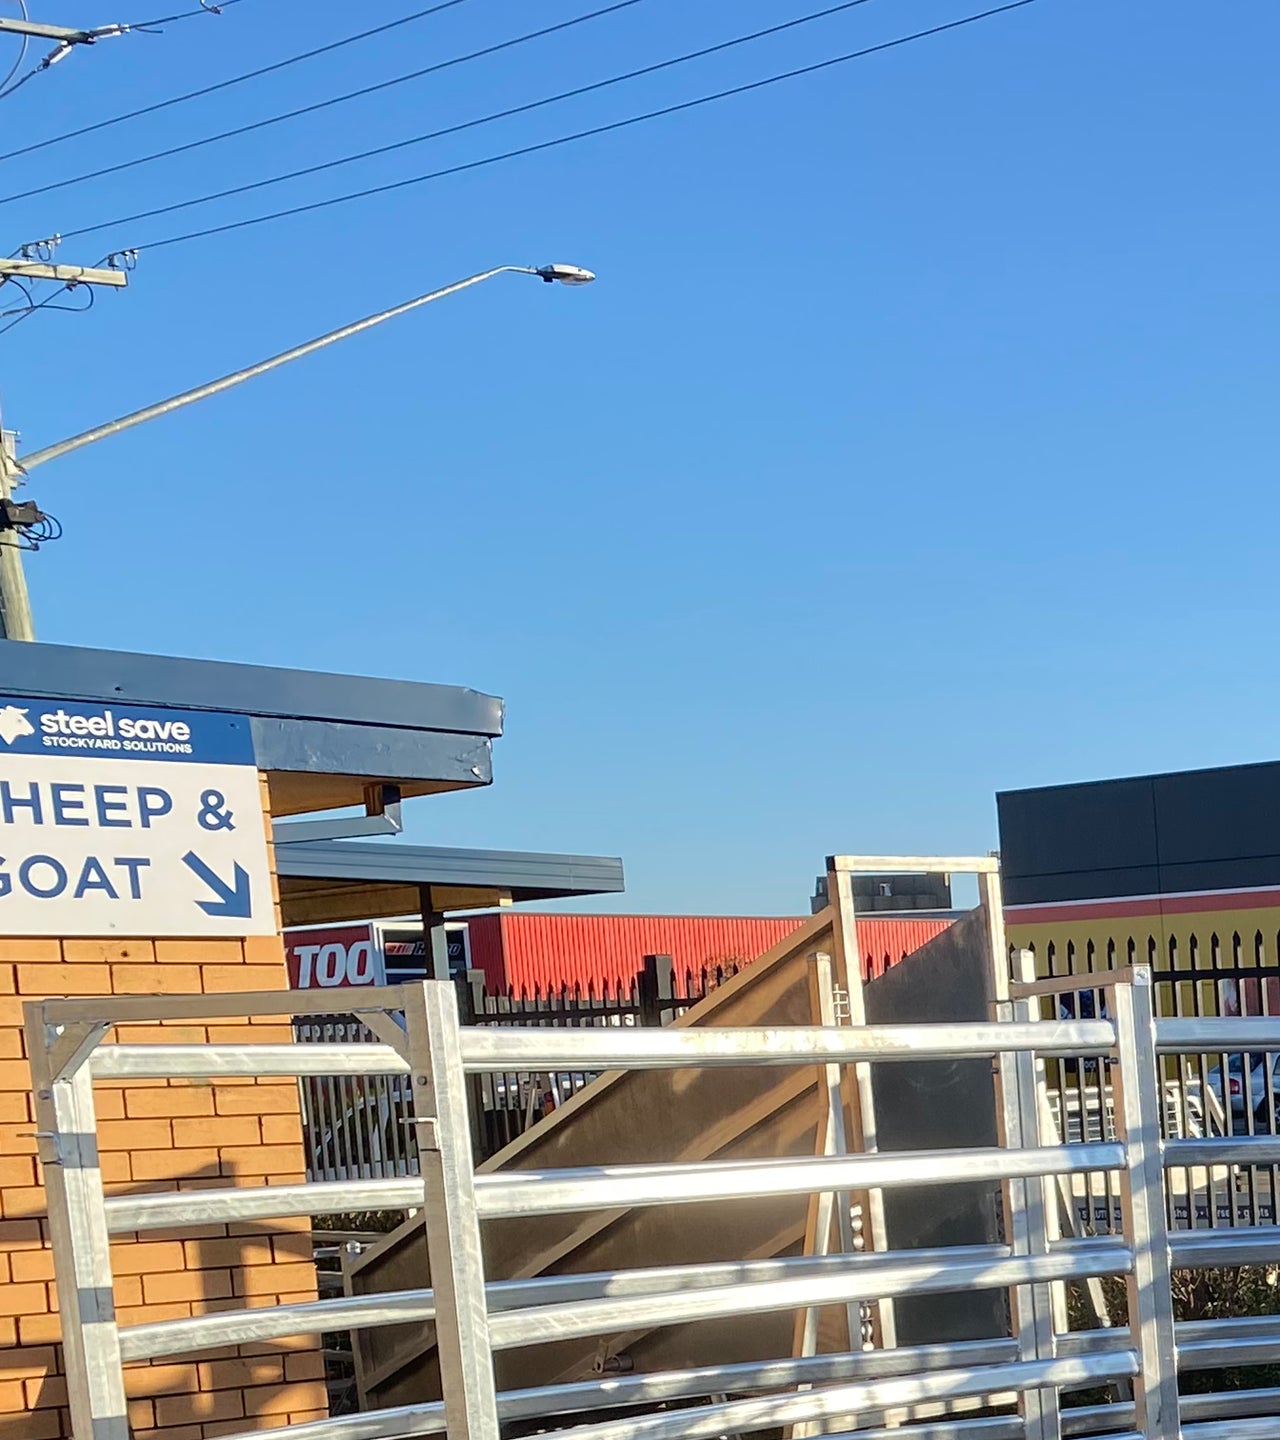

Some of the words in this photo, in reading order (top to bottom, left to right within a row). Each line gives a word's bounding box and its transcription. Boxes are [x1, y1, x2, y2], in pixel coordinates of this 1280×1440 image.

[40, 710, 114, 737] steel
[118, 717, 190, 741] save
[42, 736, 121, 751] STOCKYARD
[123, 741, 193, 754] SOLUTIONS
[197, 788, 236, 832] &
